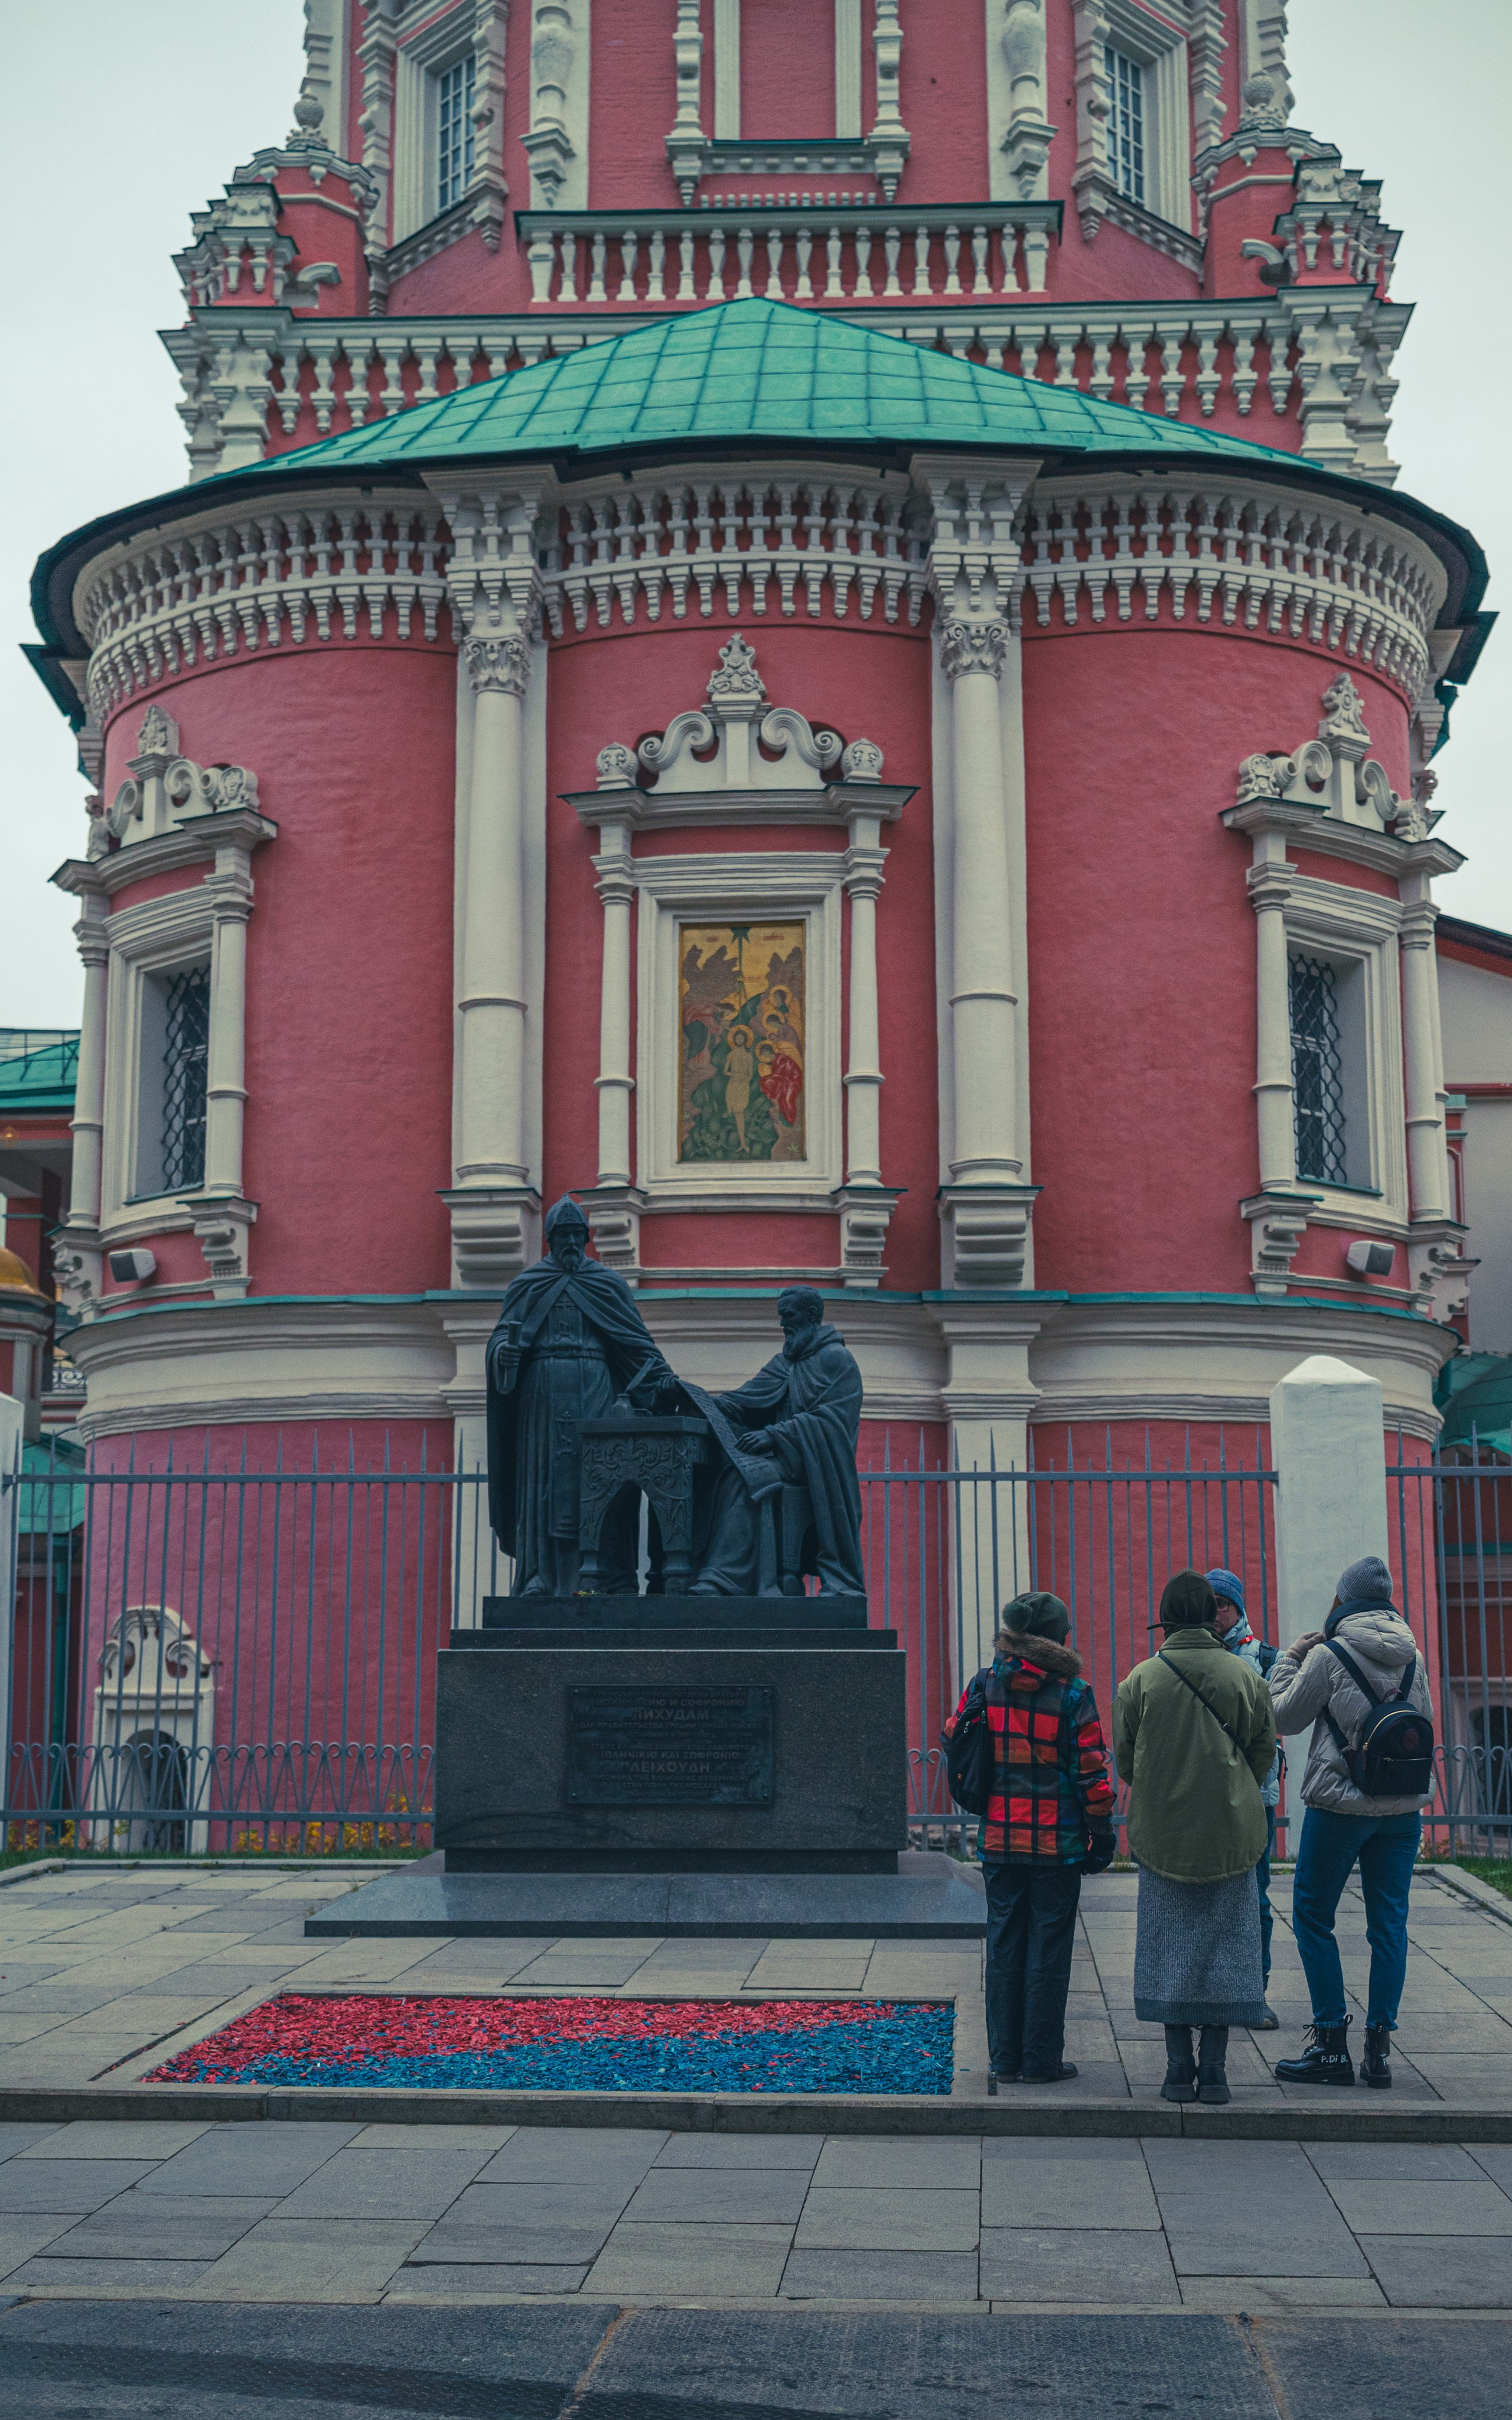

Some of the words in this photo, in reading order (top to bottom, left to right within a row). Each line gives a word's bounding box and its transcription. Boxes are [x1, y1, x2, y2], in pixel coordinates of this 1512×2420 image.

[631, 1709, 709, 1721] ЛИХУДАМ
[601, 1751, 657, 1759] ΙΩΑΝΝΙΚΙΟ
[630, 1762, 710, 1772] ΛΕΙΧΟΥΔΗ
[1321, 2055, 1338, 2063] P.Di
[1340, 2054, 1349, 2063] B.
